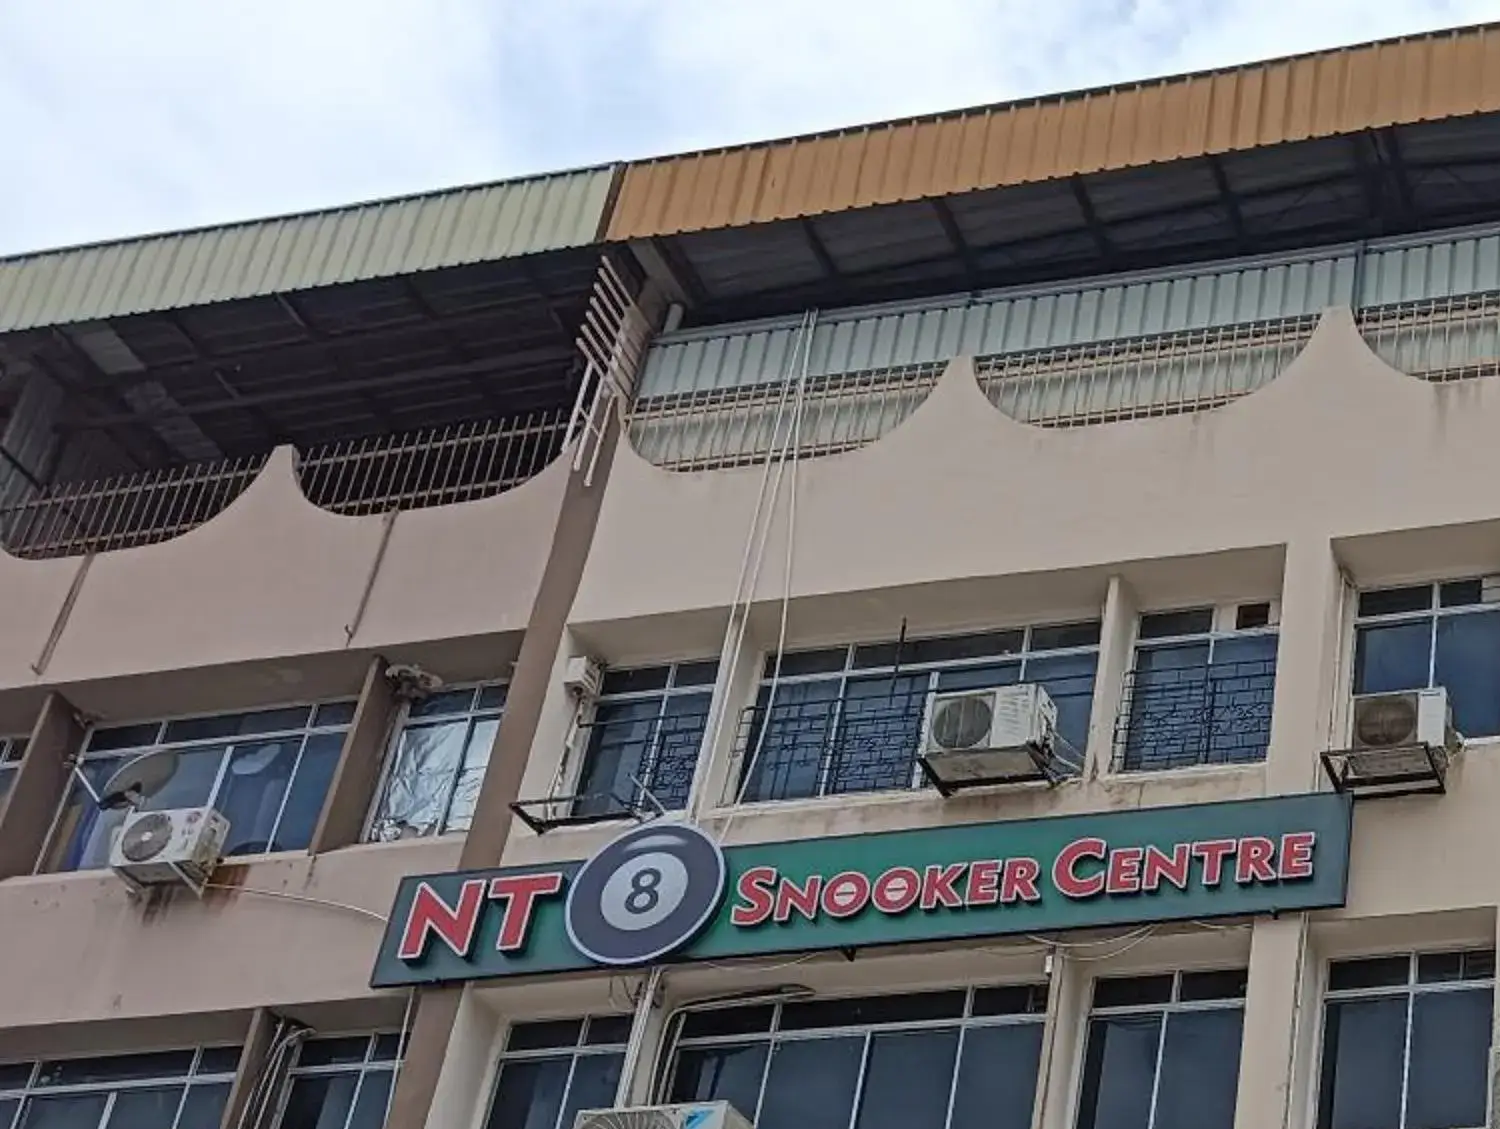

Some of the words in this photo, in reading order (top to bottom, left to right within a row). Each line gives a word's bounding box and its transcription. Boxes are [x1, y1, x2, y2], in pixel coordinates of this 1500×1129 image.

[398, 870, 564, 963] NT
[625, 866, 661, 914] 8
[1050, 832, 1317, 900] CENTRE
